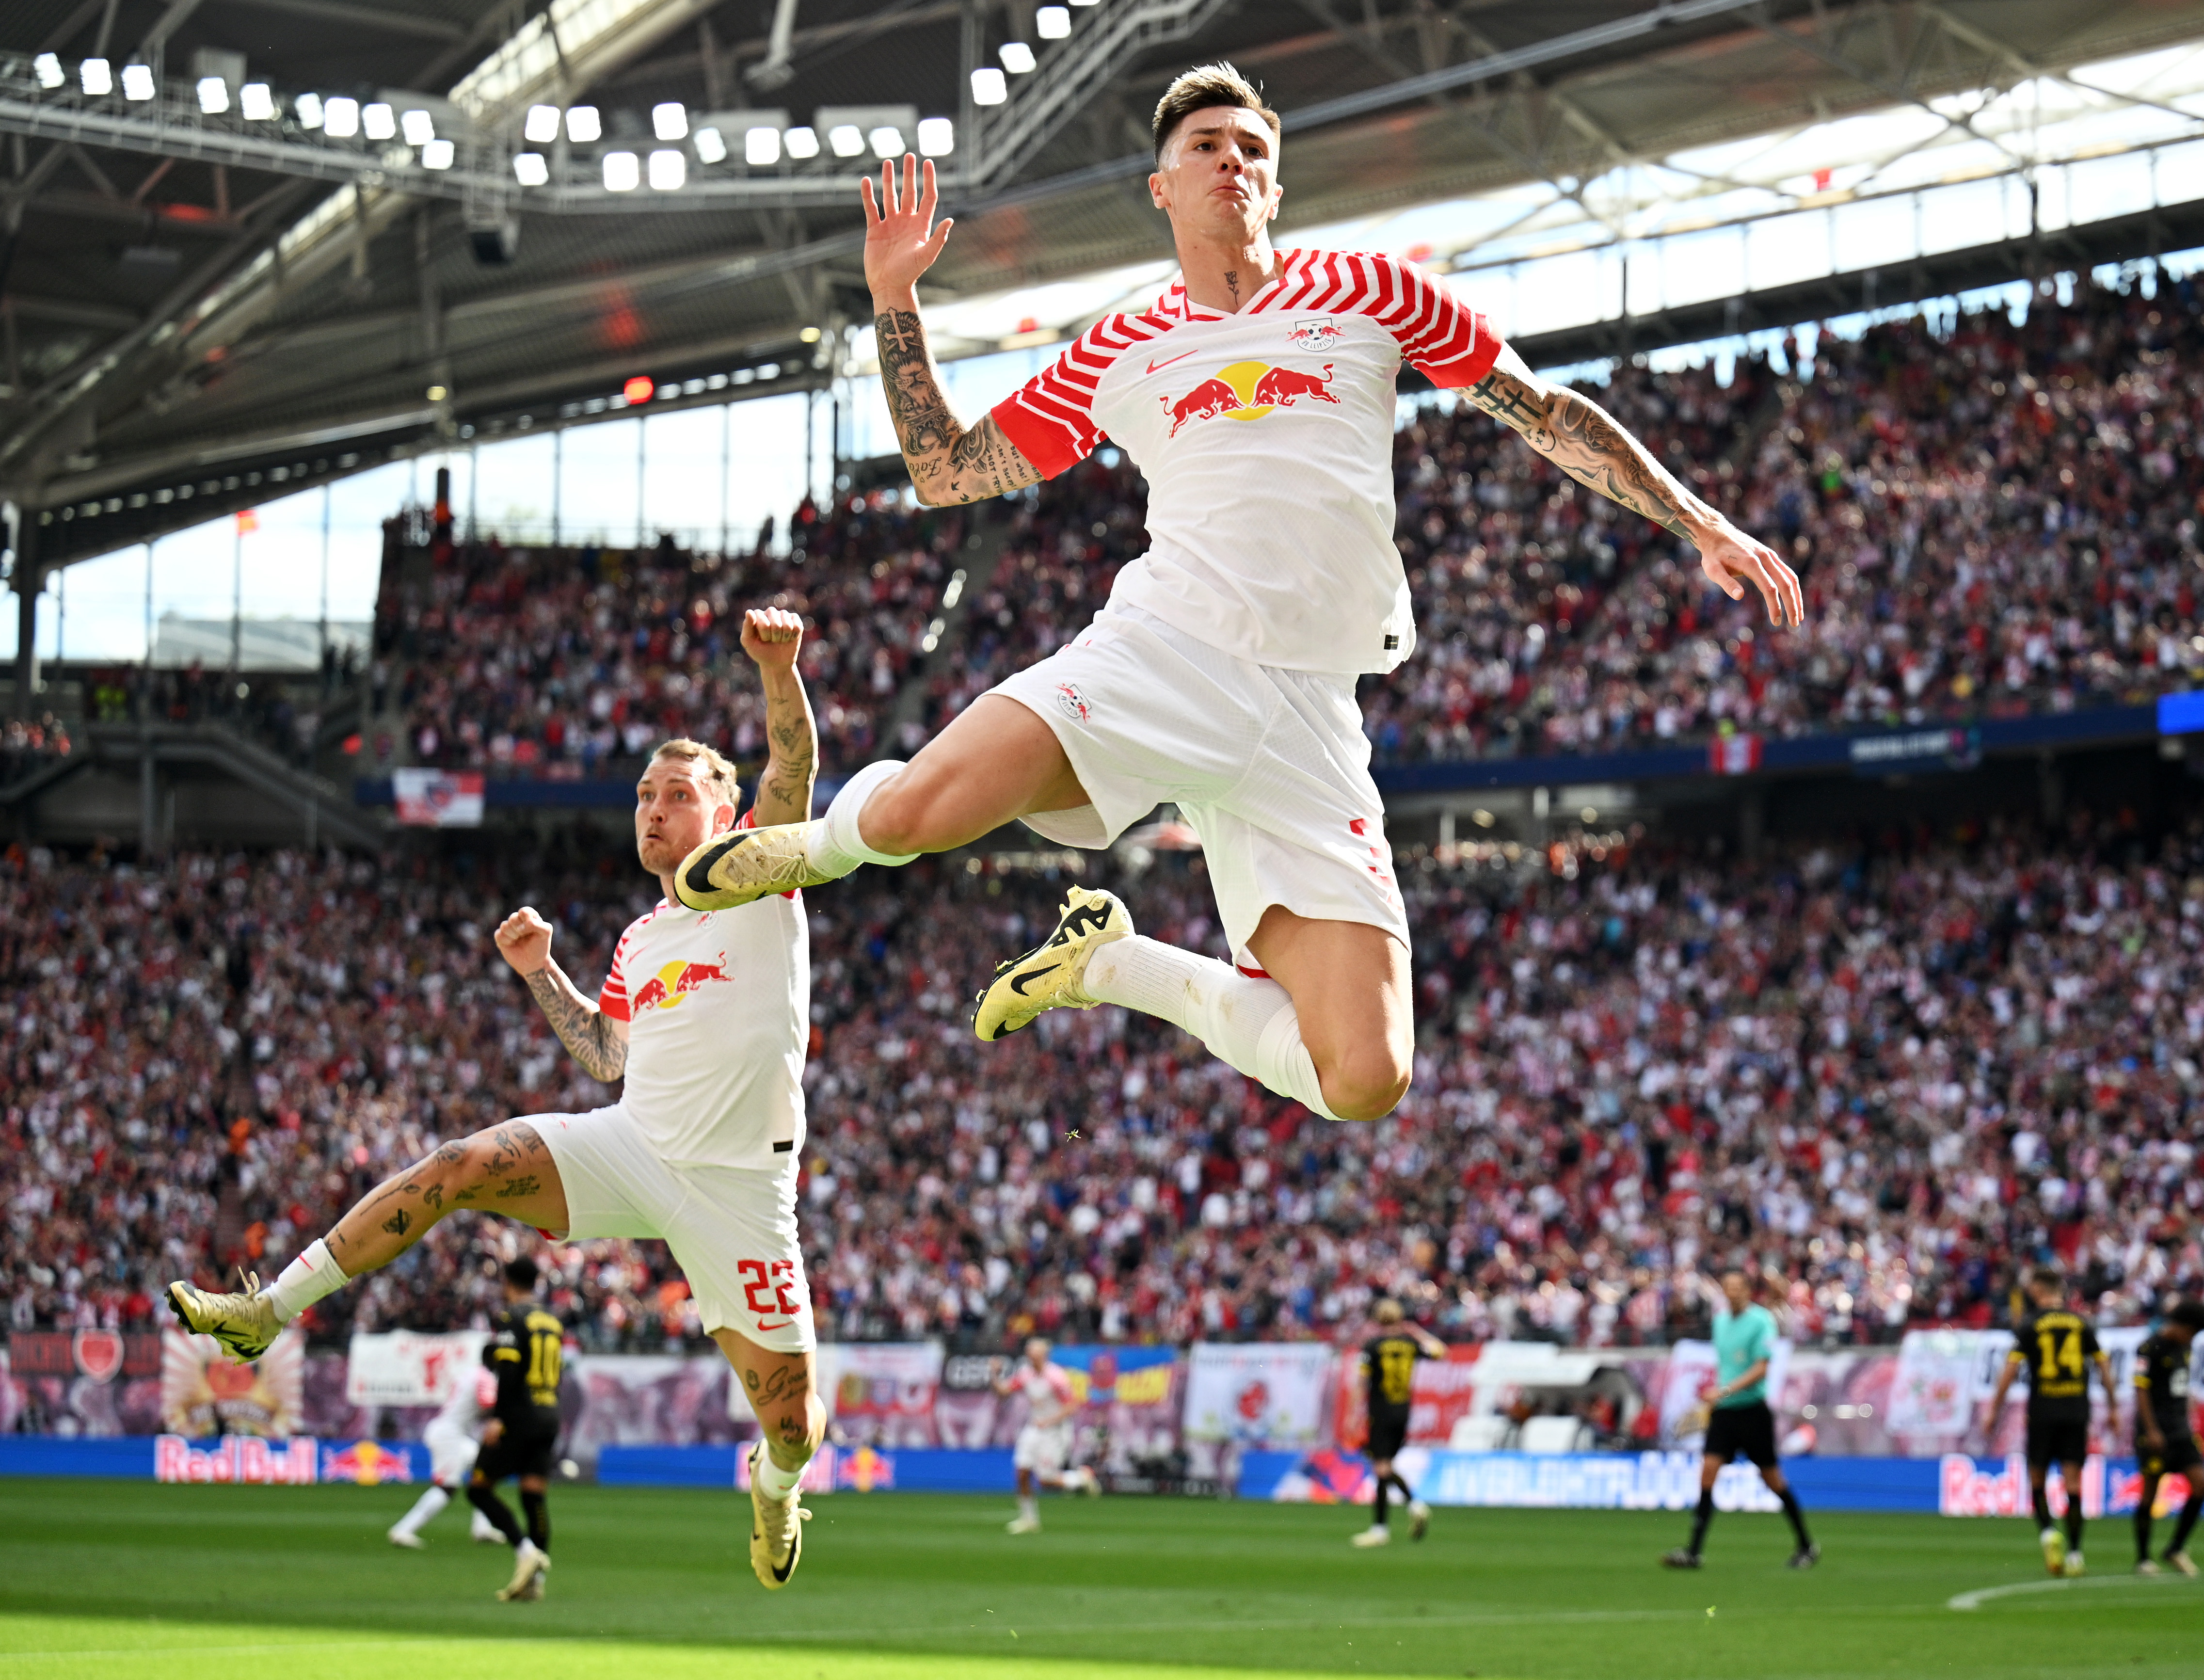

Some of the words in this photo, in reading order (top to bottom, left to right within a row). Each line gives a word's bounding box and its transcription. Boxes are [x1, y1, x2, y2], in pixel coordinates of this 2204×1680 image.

[1310, 338, 1332, 349] LEIPZIG
[987, 454, 996, 471] NOT
[996, 443, 1006, 464] can't
[1016, 462, 1027, 479] what
[737, 1259, 801, 1314] 22
[525, 1330, 562, 1389] 10
[2037, 1330, 2084, 1378] 14
[155, 1435, 236, 1484] Red
[238, 1435, 318, 1485] Bull
[1939, 1453, 2021, 1517] Red
